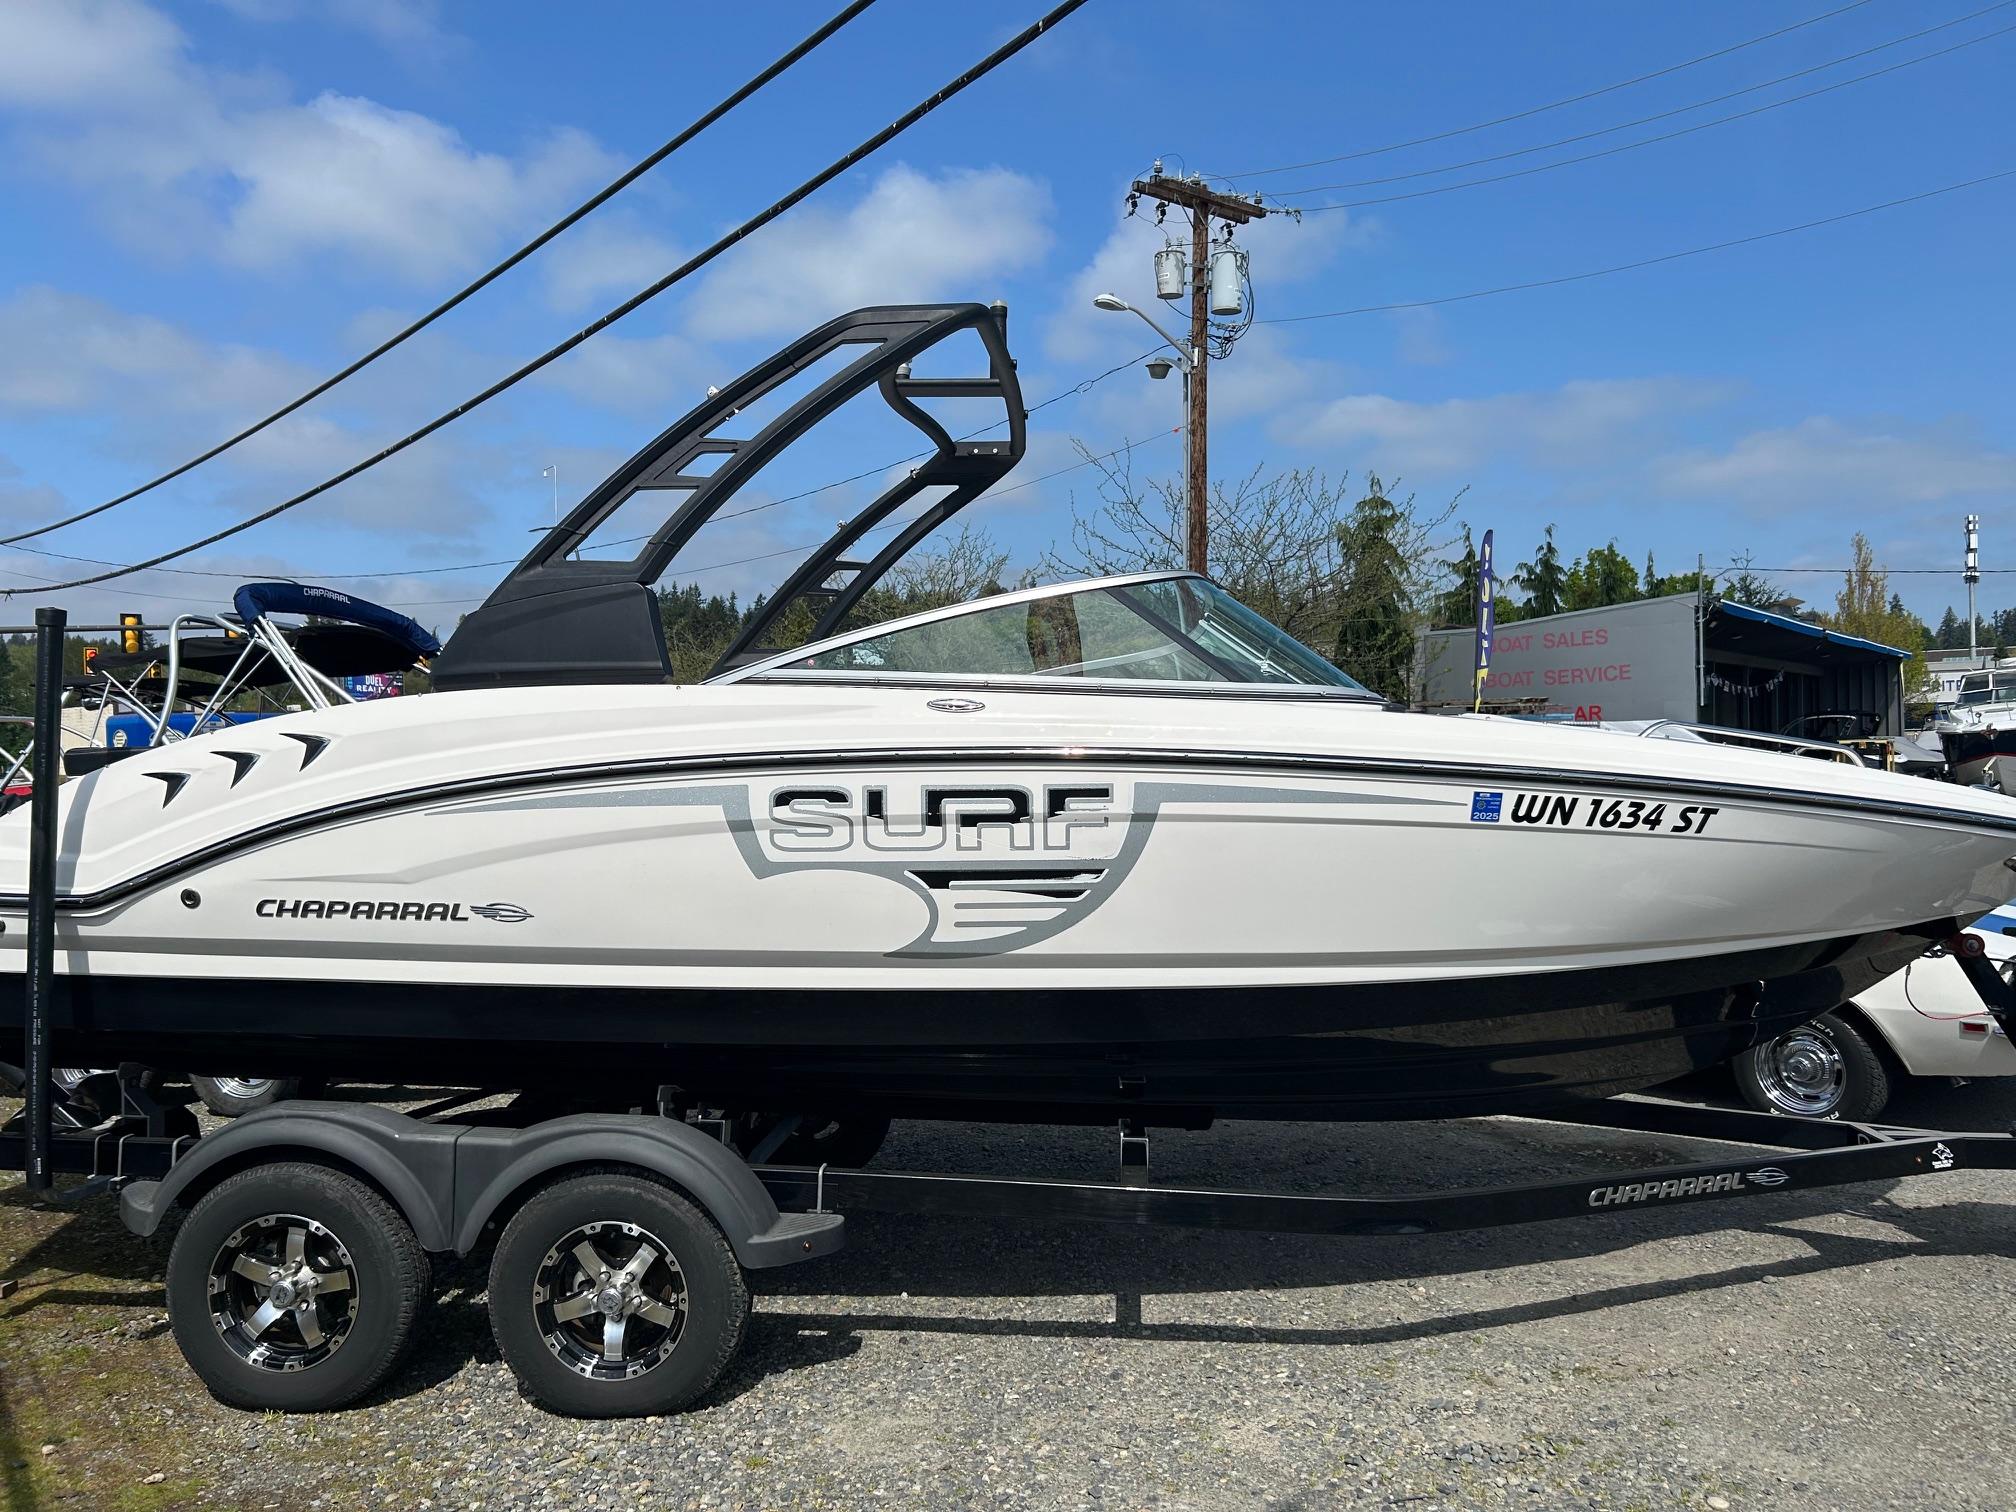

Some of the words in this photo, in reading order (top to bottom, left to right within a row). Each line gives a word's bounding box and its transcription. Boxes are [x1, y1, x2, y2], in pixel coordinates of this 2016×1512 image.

[303, 588, 351, 604] CHAPARRAL
[1543, 629, 1609, 649] SALES
[365, 674, 383, 687] DUEL
[1485, 671, 1535, 688] BOAT
[1543, 664, 1632, 686] SERVICE
[768, 784, 1114, 852] SURF
[1473, 812, 1499, 820] 2025
[1511, 793, 1579, 826] WN
[1585, 798, 1667, 831] 1634
[1670, 806, 1720, 834] ST
[256, 899, 469, 922] CHAPARRAL
[1588, 1171, 1746, 1208] CHAPARRAL
